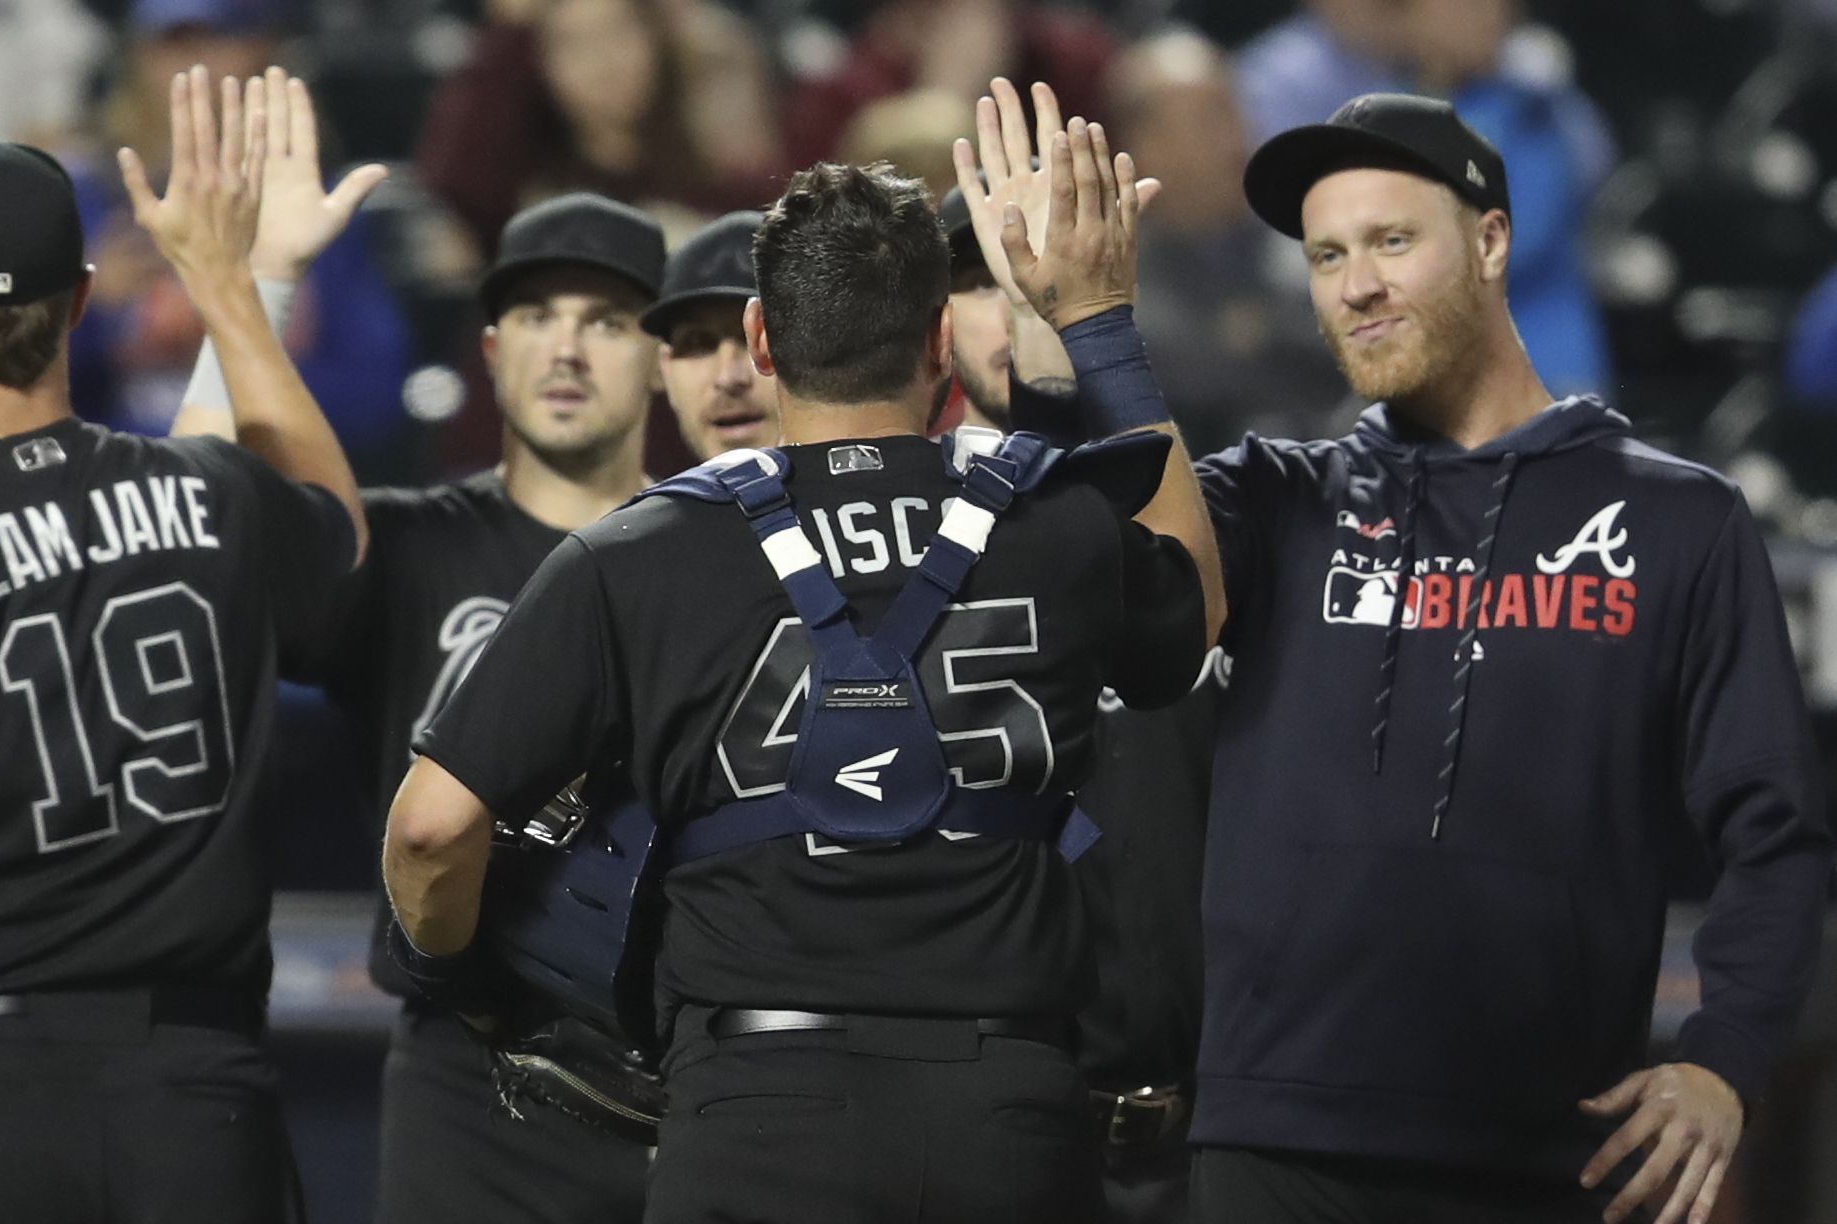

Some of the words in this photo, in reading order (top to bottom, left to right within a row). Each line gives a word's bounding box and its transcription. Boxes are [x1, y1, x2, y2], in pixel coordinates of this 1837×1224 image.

[87, 475, 220, 564] JAKE
[1536, 500, 1636, 578] A
[1420, 573, 1637, 635] BRAVES
